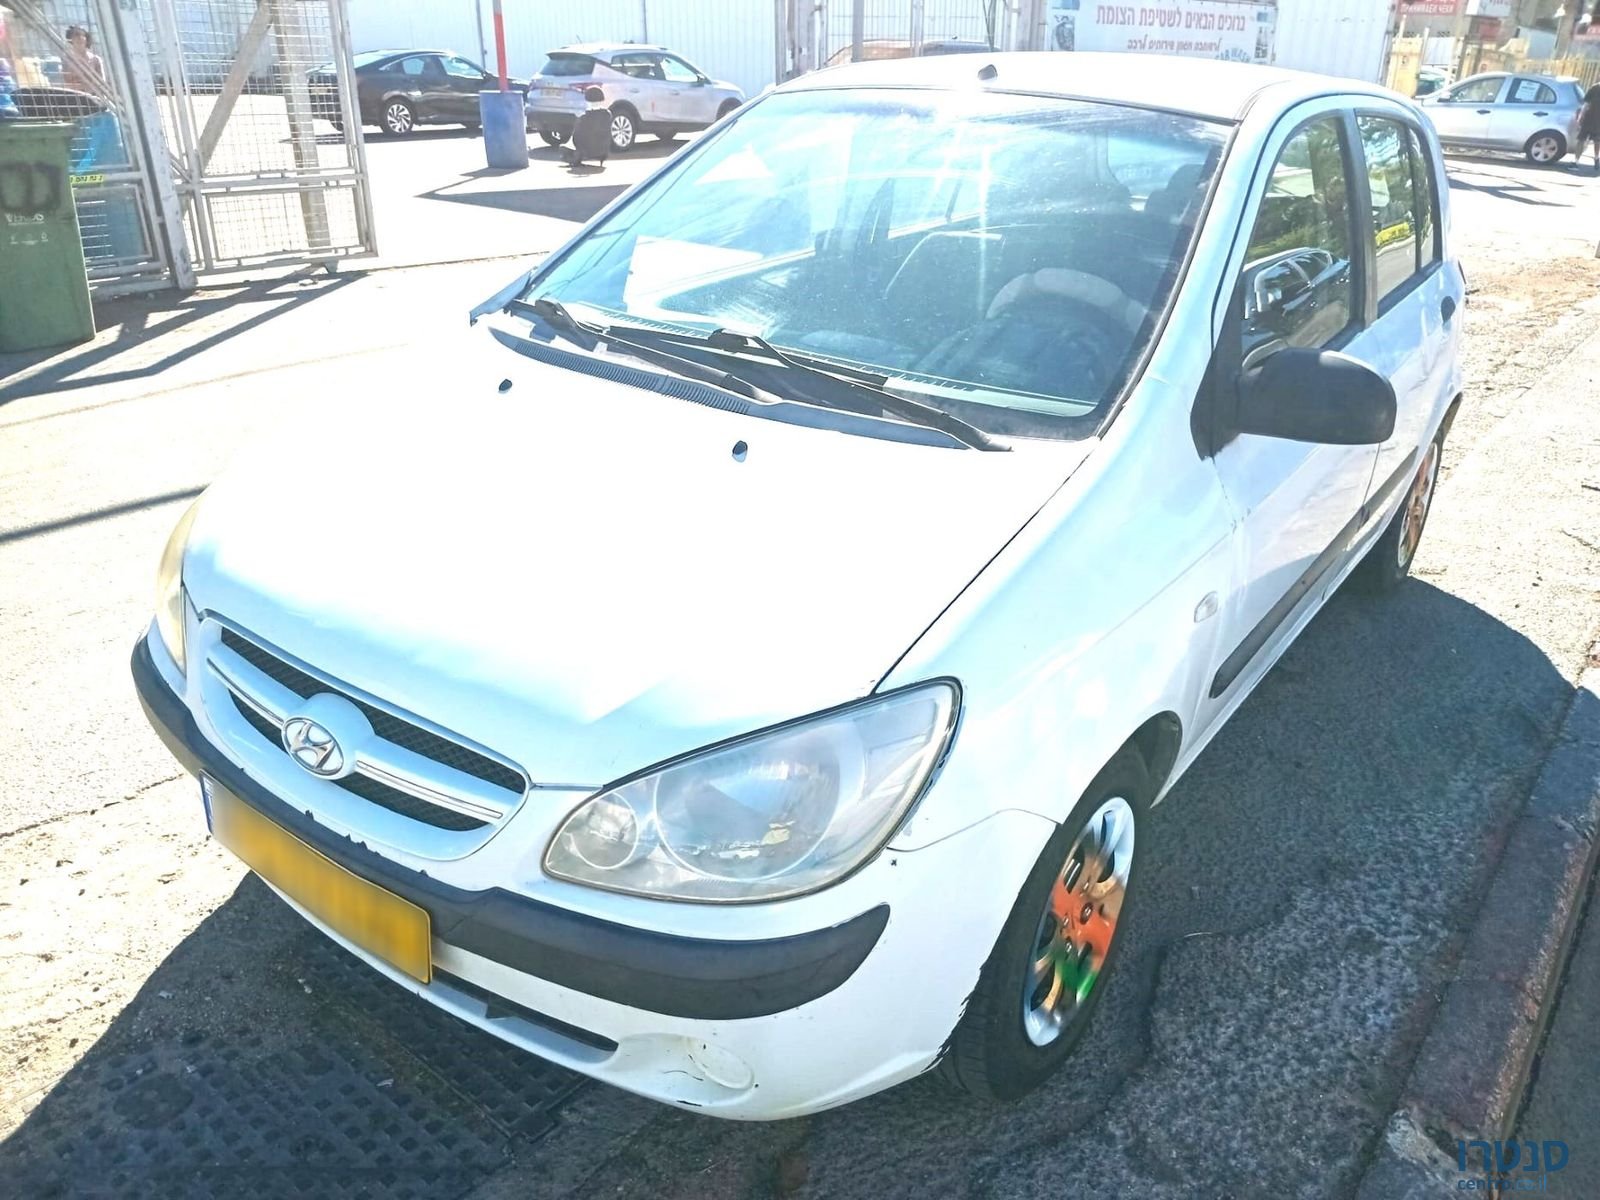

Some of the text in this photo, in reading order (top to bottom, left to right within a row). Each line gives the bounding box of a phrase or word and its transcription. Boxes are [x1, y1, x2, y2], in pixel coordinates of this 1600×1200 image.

[1096, 5, 1135, 25] הצומת
[1139, 6, 1182, 27] לשטיפת
[1184, 11, 1215, 30] הבאים
